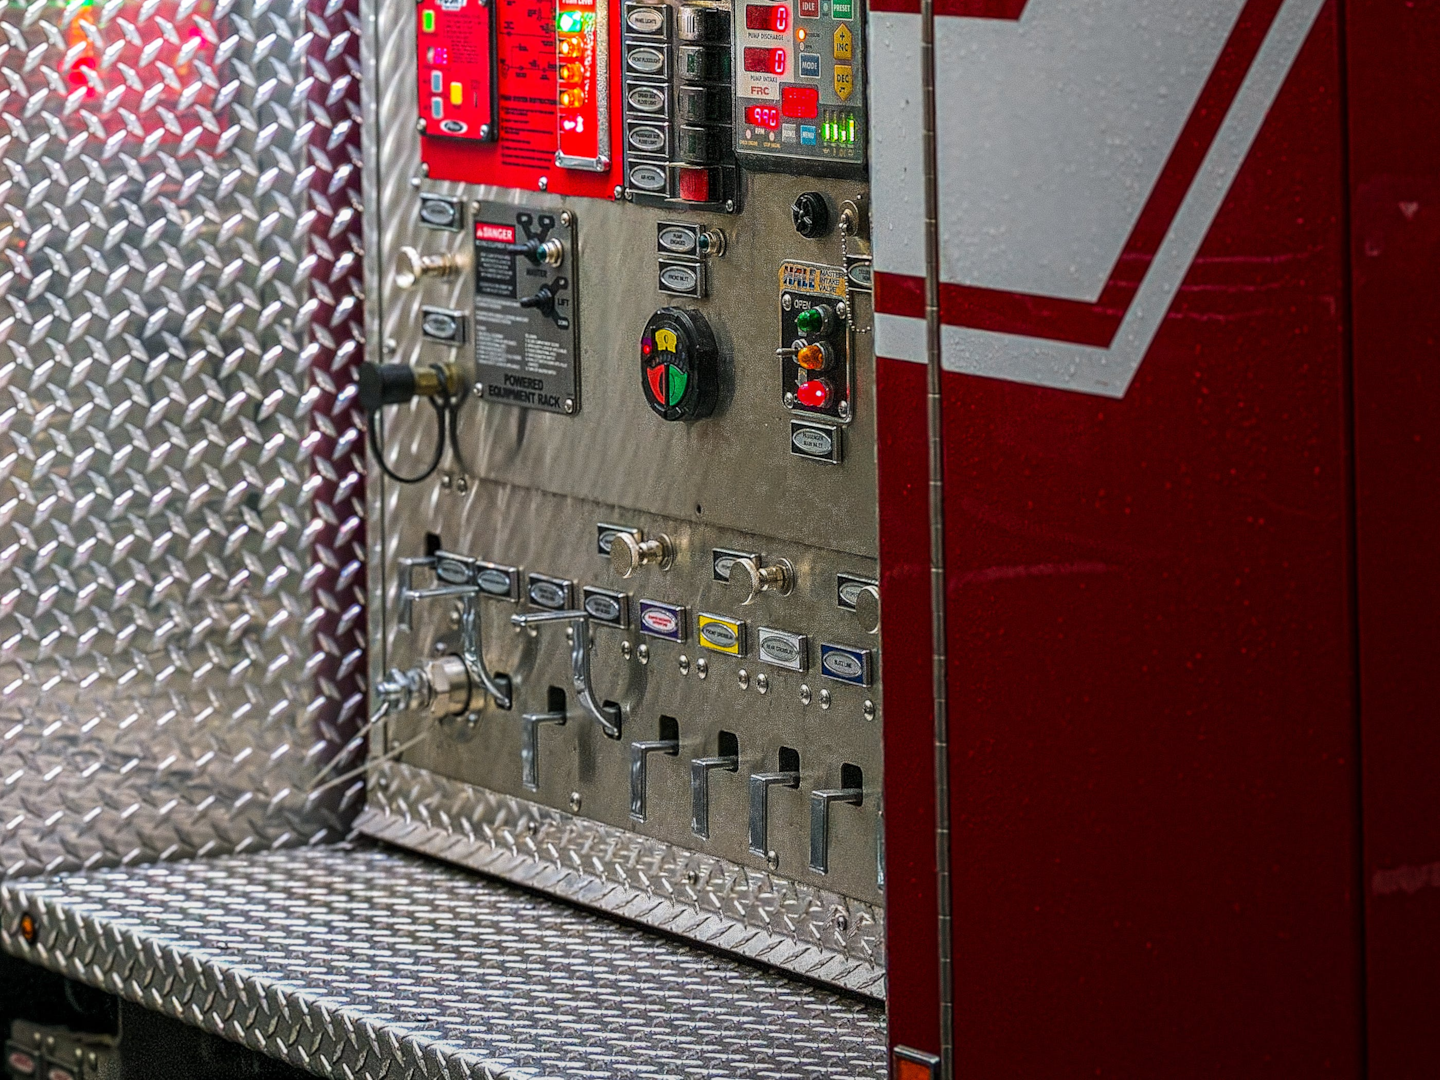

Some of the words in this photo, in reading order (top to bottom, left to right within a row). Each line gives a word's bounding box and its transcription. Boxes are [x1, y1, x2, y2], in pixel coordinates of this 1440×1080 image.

[802, 1, 815, 11] IDLE
[833, 3, 851, 13] PRESET
[776, 7, 786, 30] 0
[760, 33, 784, 41] DISCHARGE
[836, 42, 849, 52] INC
[774, 50, 785, 73] 0
[801, 61, 818, 70] MODE
[836, 74, 849, 83] DEC
[750, 85, 770, 96] FRC
[754, 107, 776, 126] 990
[754, 127, 765, 135] RPM
[483, 226, 513, 240] DANGER
[526, 268, 548, 278] MASTER
[820, 269, 845, 279] MASTER
[820, 277, 840, 285] INTAKE
[820, 284, 837, 293] VALVE
[557, 298, 569, 307] LIFT
[793, 299, 812, 310] OPEN
[504, 373, 544, 391] POWERED
[488, 384, 536, 404] EQUIPMENT
[537, 393, 561, 409] RACK
